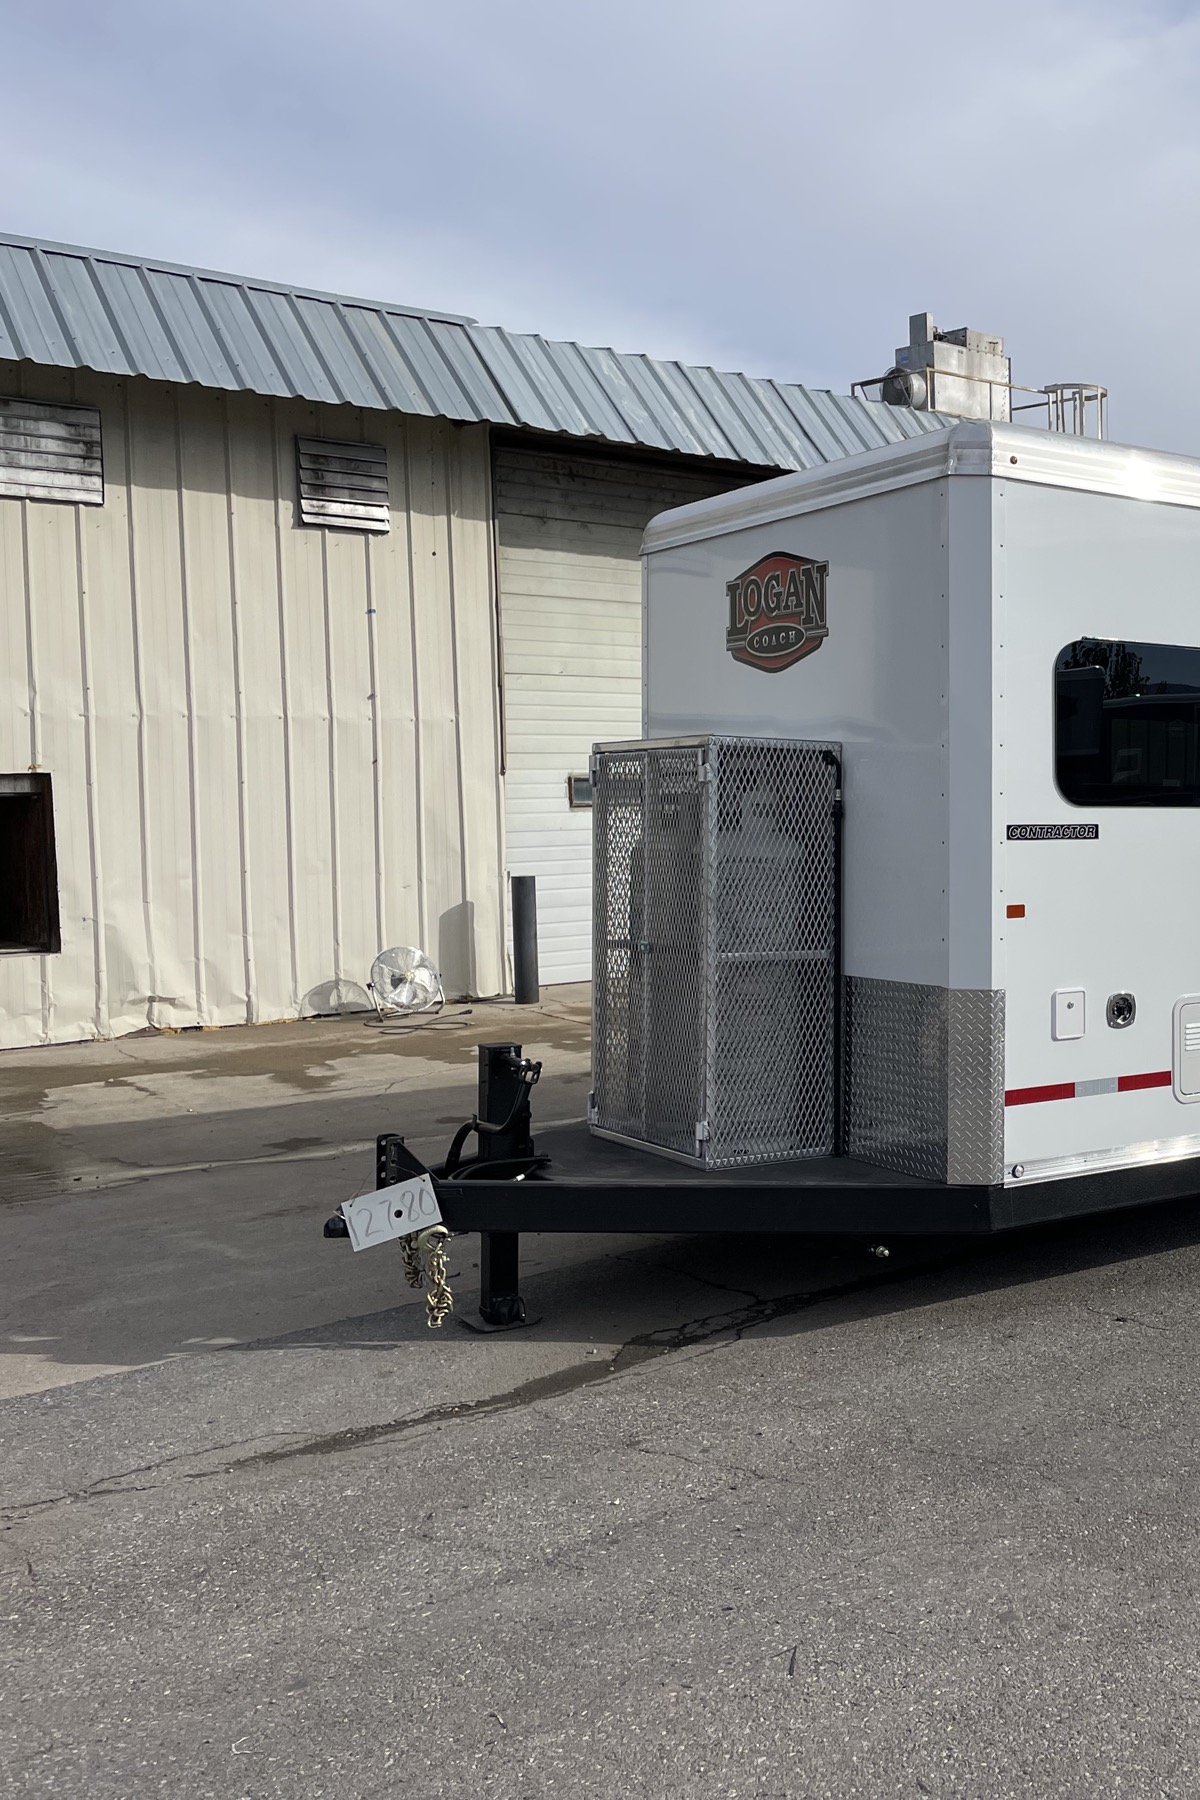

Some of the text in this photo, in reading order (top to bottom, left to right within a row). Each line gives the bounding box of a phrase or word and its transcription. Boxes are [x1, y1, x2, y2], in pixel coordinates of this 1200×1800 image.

[726, 560, 829, 638] LOGAN
[753, 631, 796, 648] COACH
[1009, 825, 1096, 839] CONTRACTOR
[348, 1187, 436, 1247] 12780
